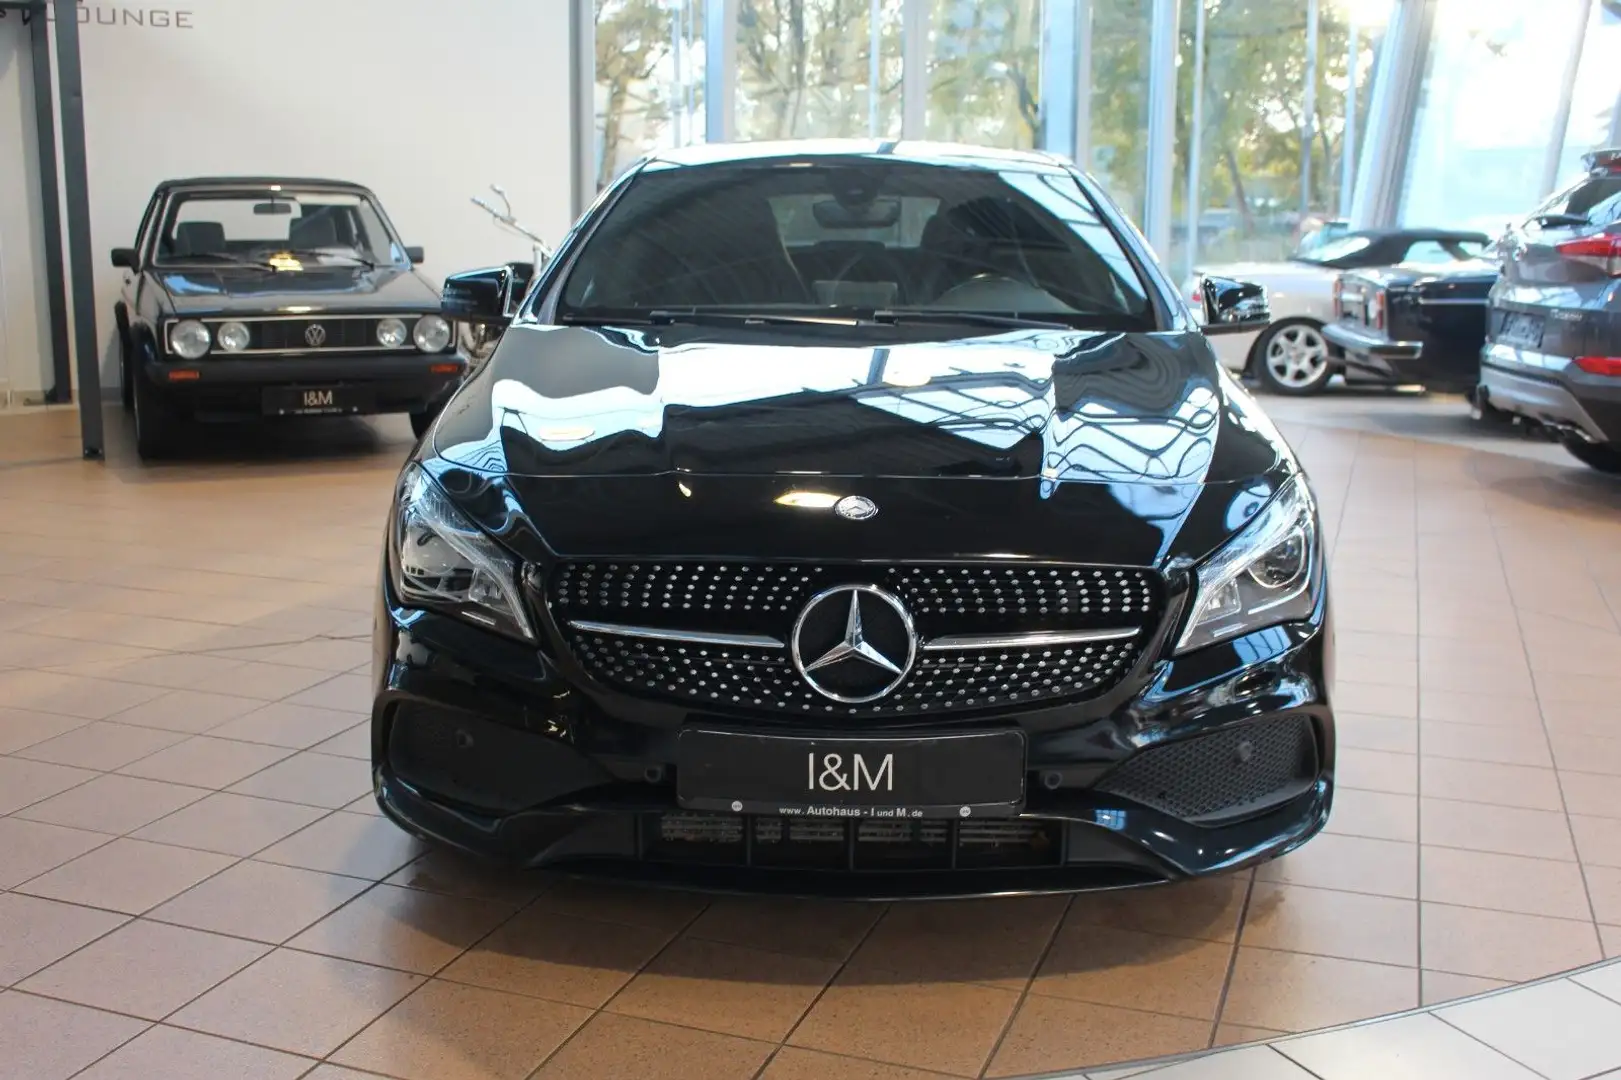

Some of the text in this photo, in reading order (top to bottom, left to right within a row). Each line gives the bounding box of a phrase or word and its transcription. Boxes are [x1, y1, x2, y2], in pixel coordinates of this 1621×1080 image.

[47, 6, 194, 29] OUNGE
[303, 390, 333, 406] I&M
[807, 752, 894, 791] I&M
[877, 809, 894, 817] und
